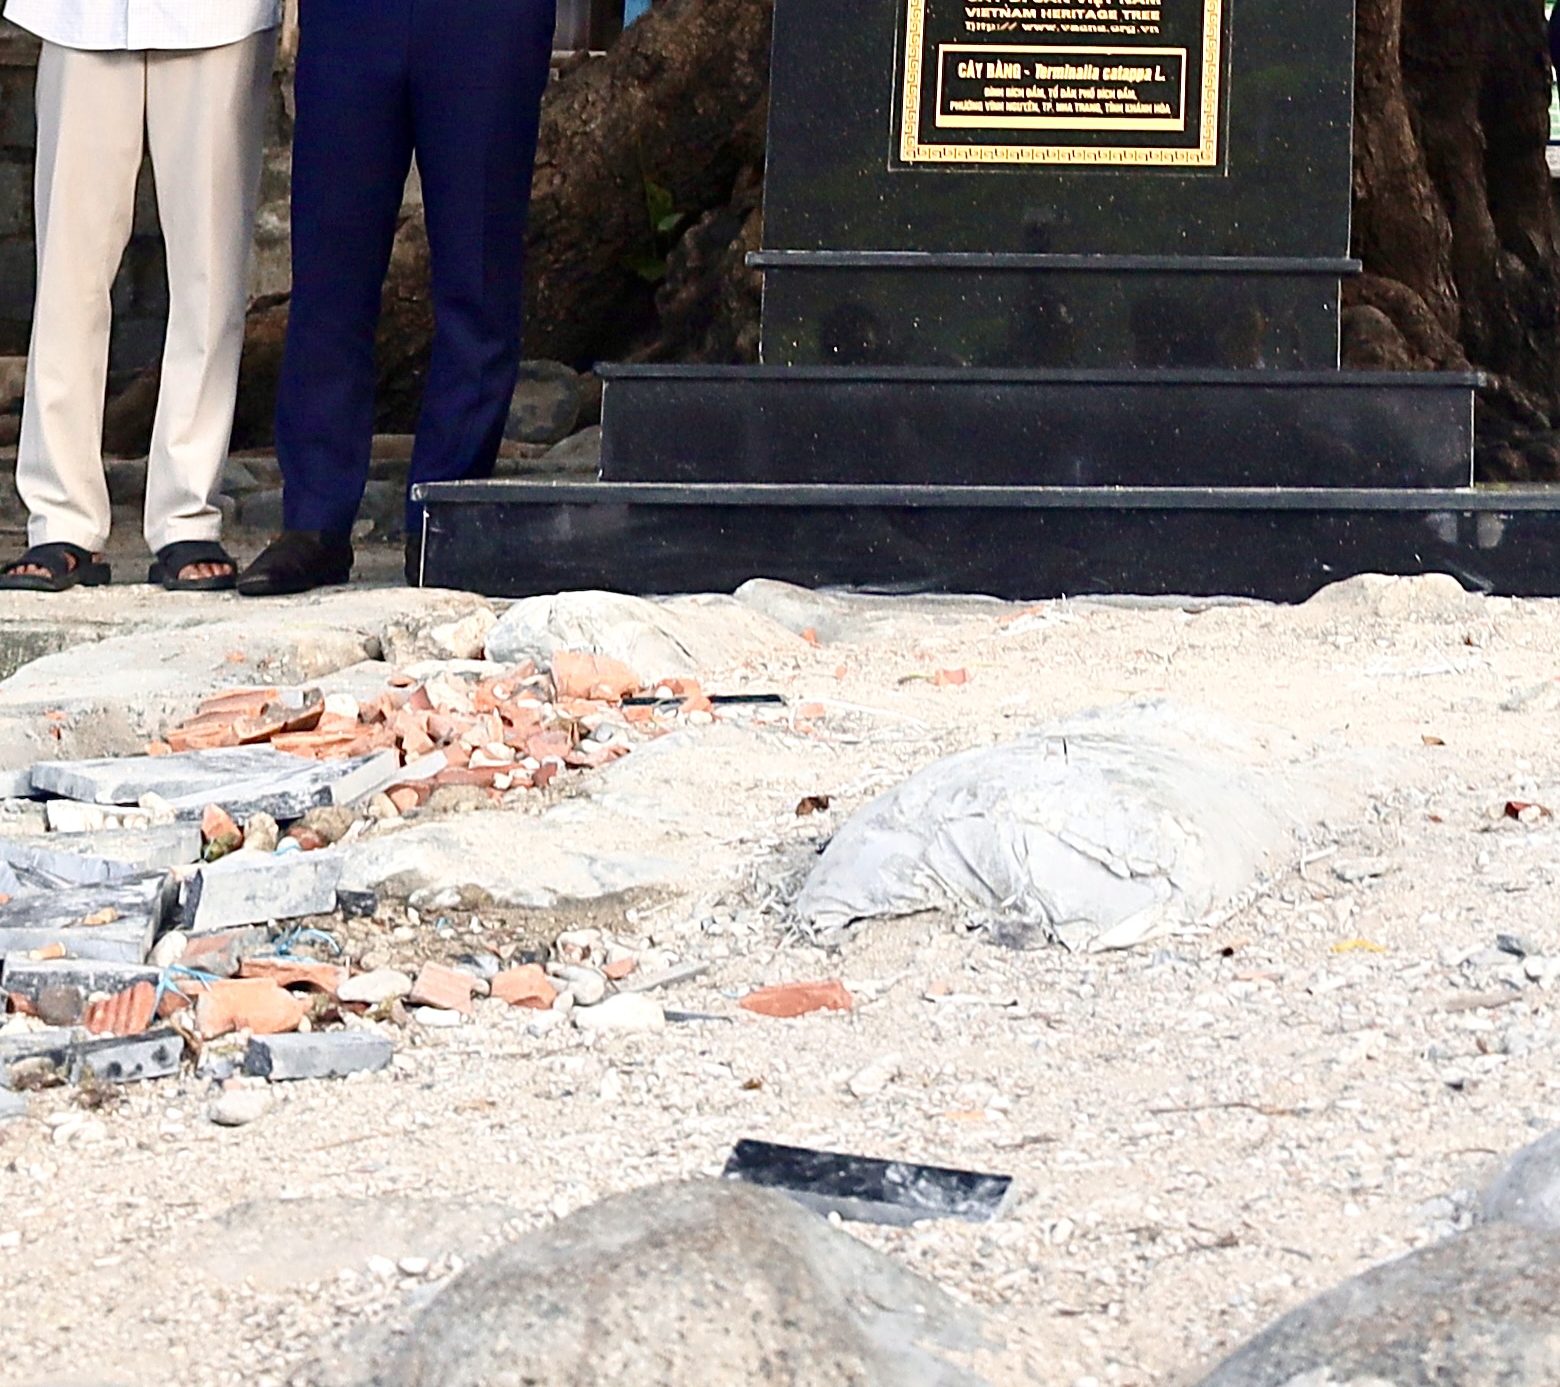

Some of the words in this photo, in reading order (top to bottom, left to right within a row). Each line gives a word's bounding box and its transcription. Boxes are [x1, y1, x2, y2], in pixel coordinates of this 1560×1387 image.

[964, 7, 1036, 19] VIETNAM
[1040, 9, 1118, 21] HERITAGE
[1122, 10, 1160, 21] TREE
[957, 58, 983, 79] CÂY
[986, 58, 1022, 80] BÀNG
[1034, 63, 1099, 81] Terminalia
[1102, 65, 1153, 83] catappa
